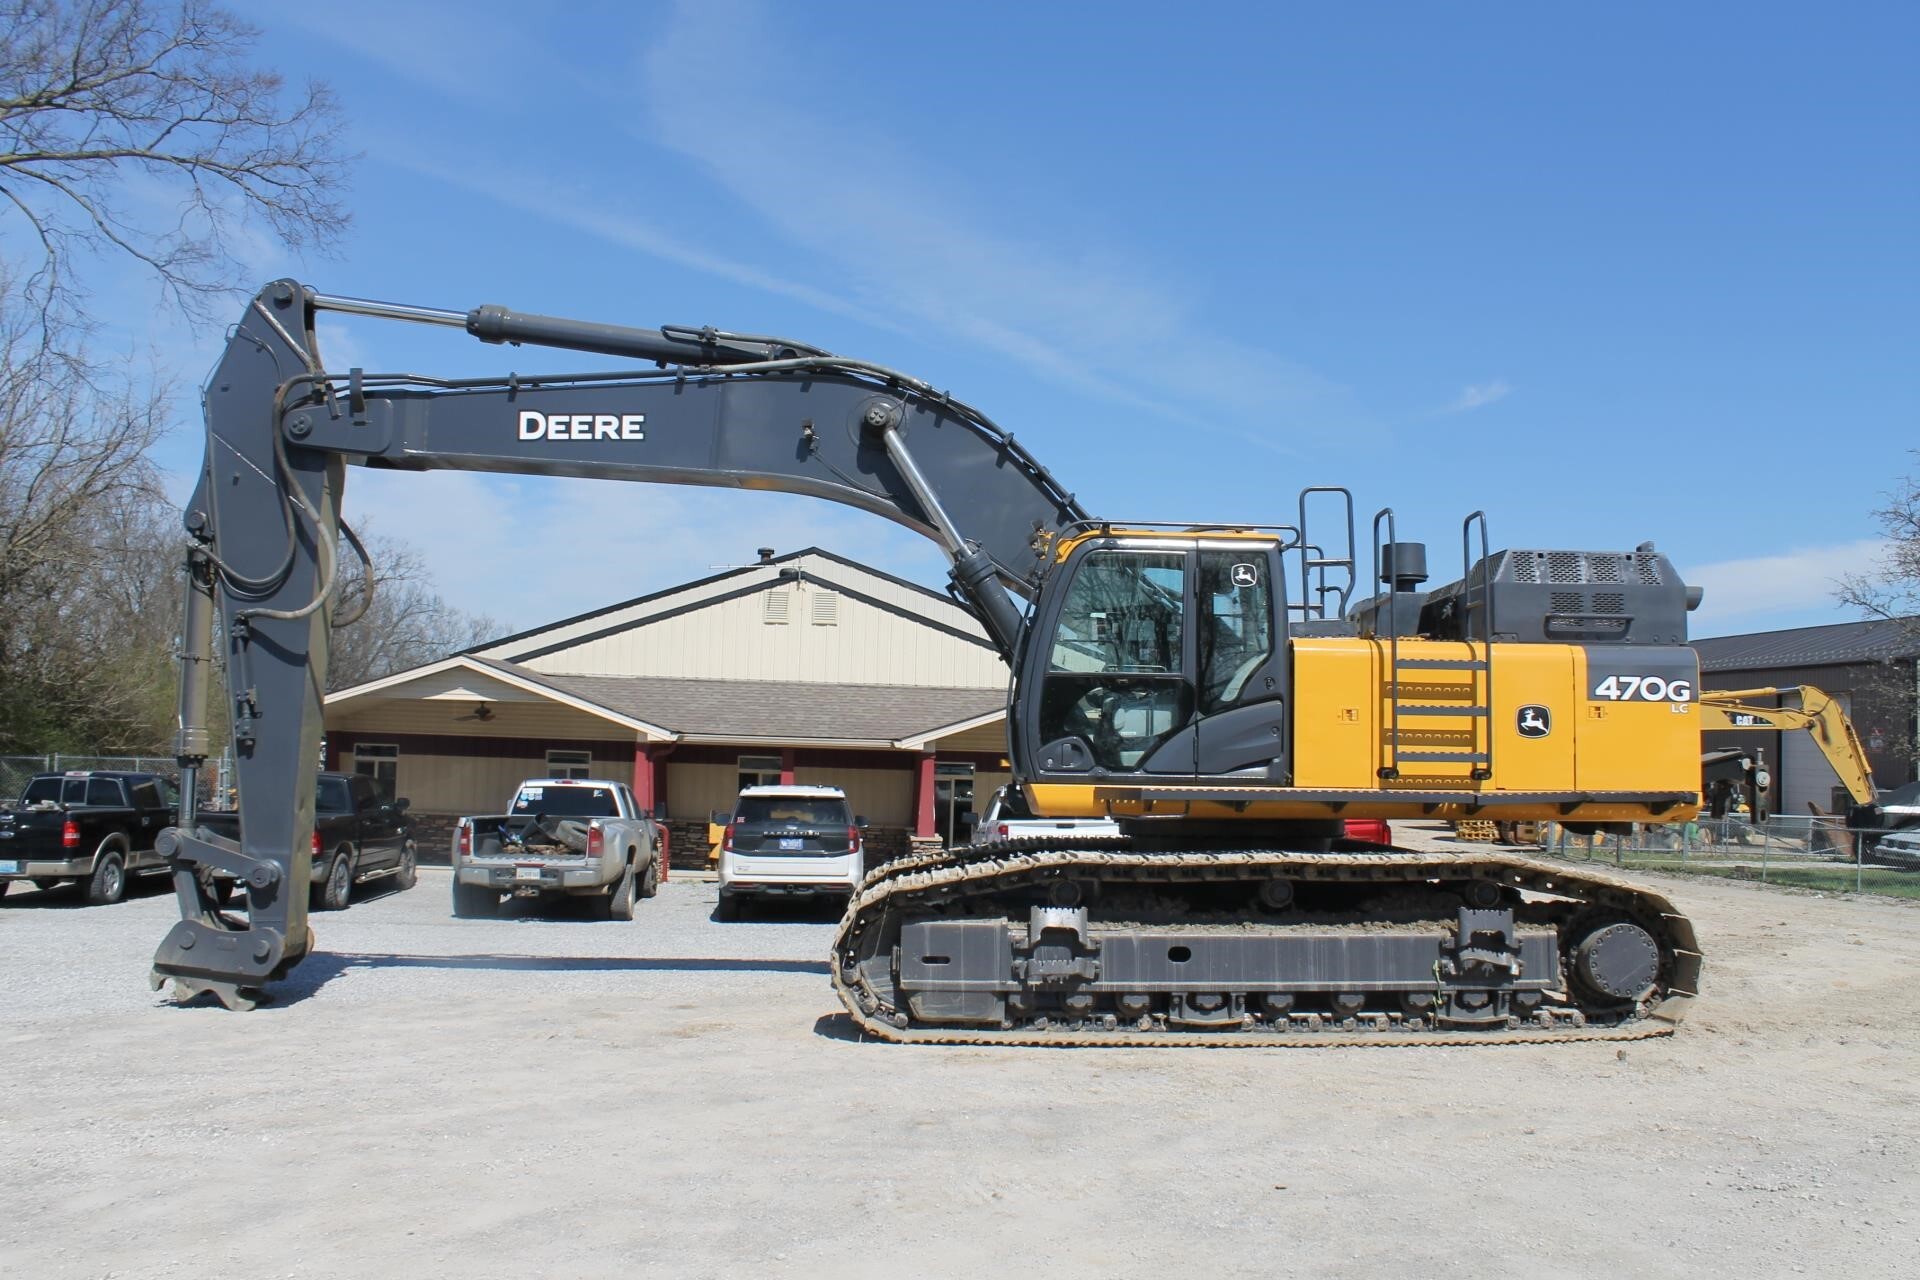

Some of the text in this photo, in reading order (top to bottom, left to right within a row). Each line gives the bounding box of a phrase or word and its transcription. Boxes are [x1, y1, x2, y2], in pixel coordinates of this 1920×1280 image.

[519, 410, 645, 440] DEERE
[1594, 675, 1691, 702] 470G
[1671, 703, 1689, 713] LC
[1736, 715, 1754, 725] CAT
